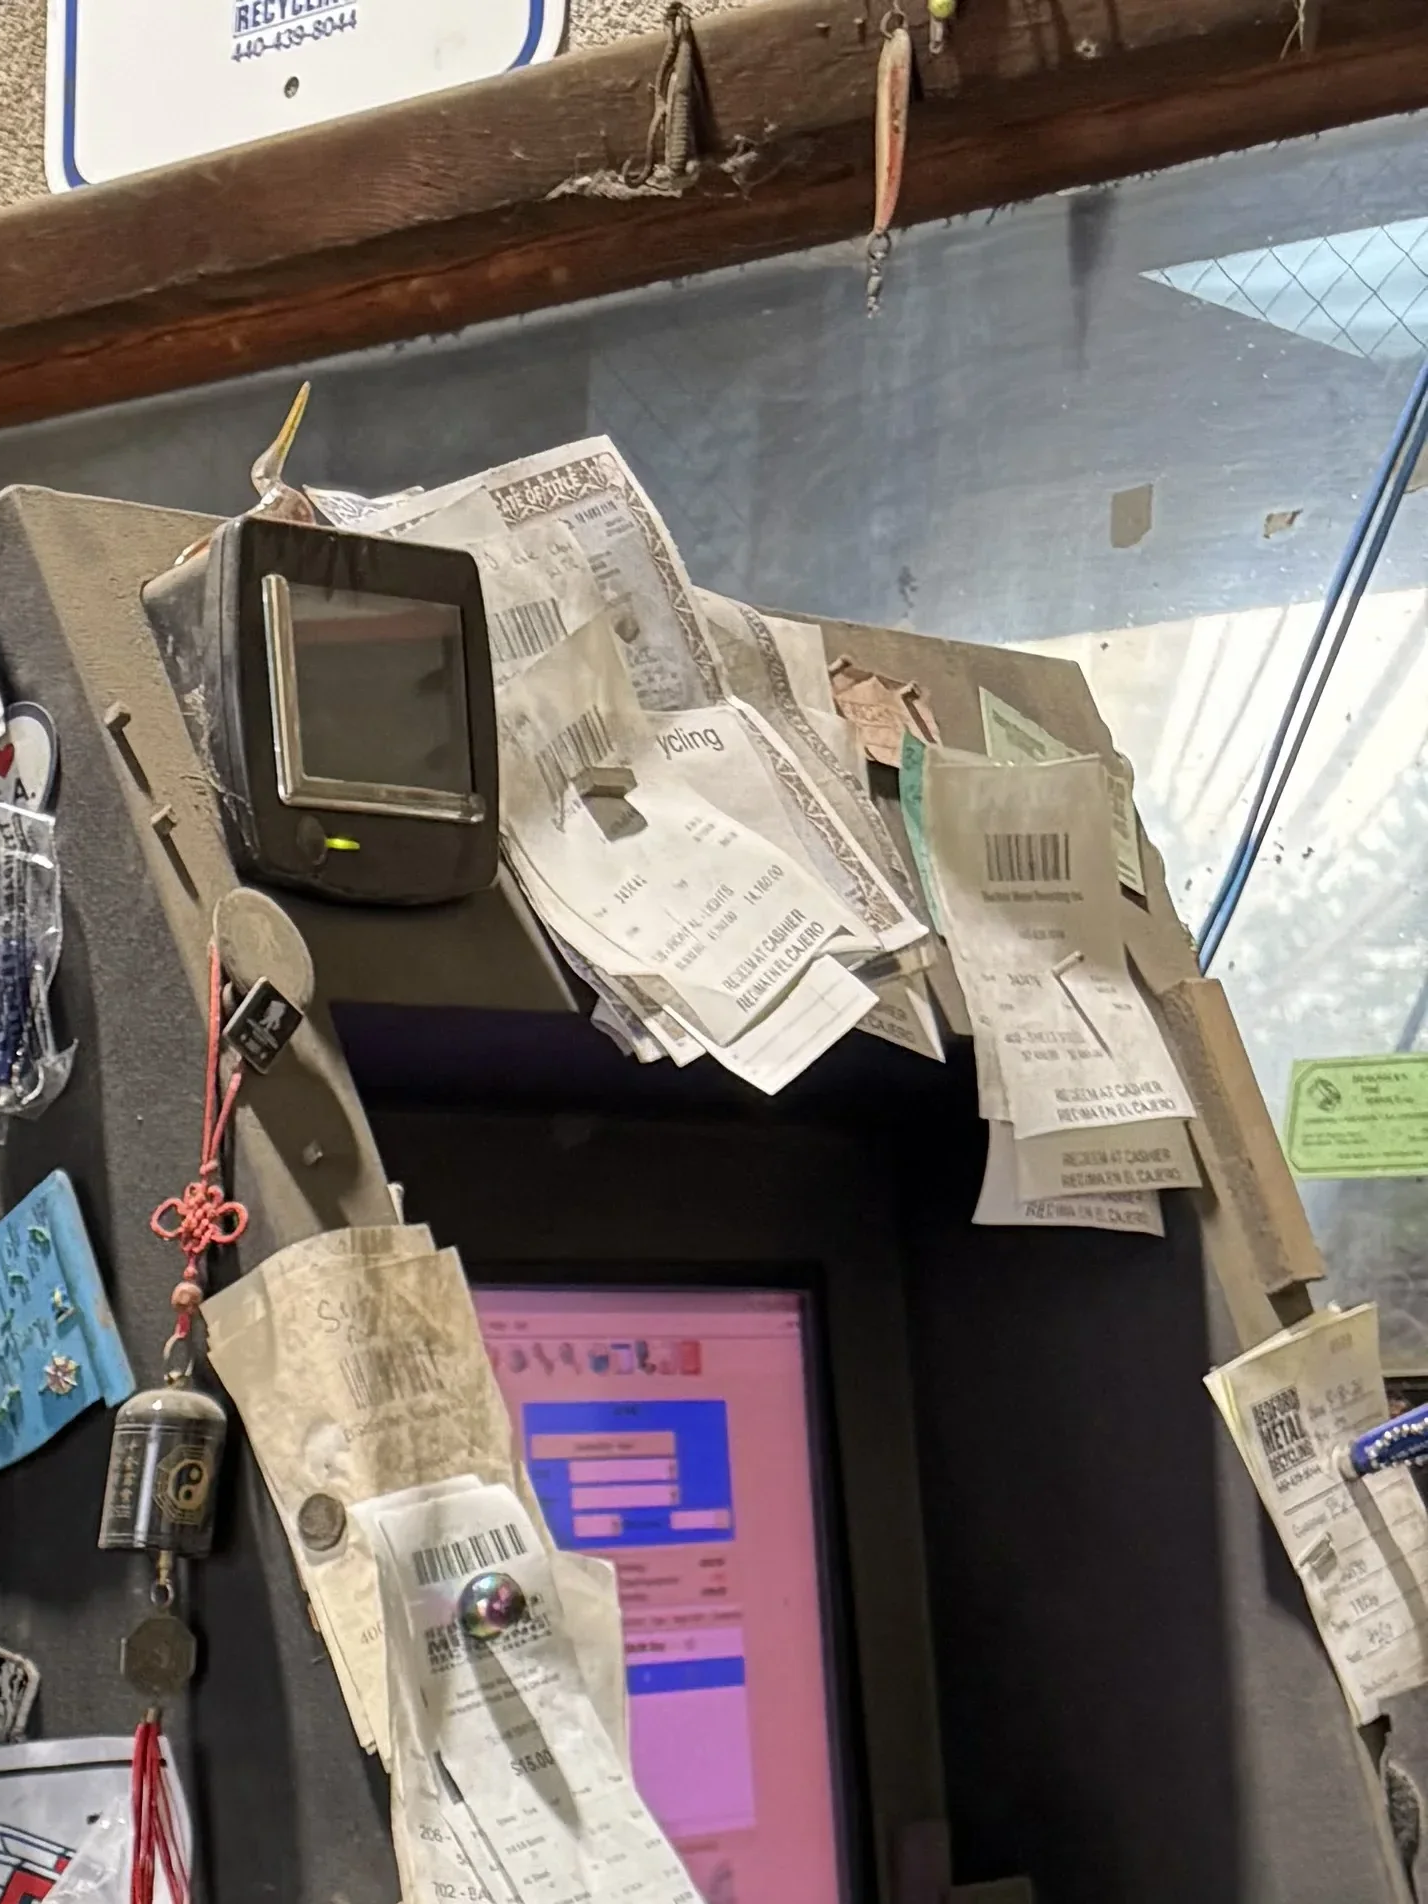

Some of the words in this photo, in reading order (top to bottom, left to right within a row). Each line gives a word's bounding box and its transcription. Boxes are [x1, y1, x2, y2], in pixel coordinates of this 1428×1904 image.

[231, 8, 357, 62] 440-439-8044
[762, 909, 807, 952] CASHIER
[785, 921, 825, 962] CAJERO
